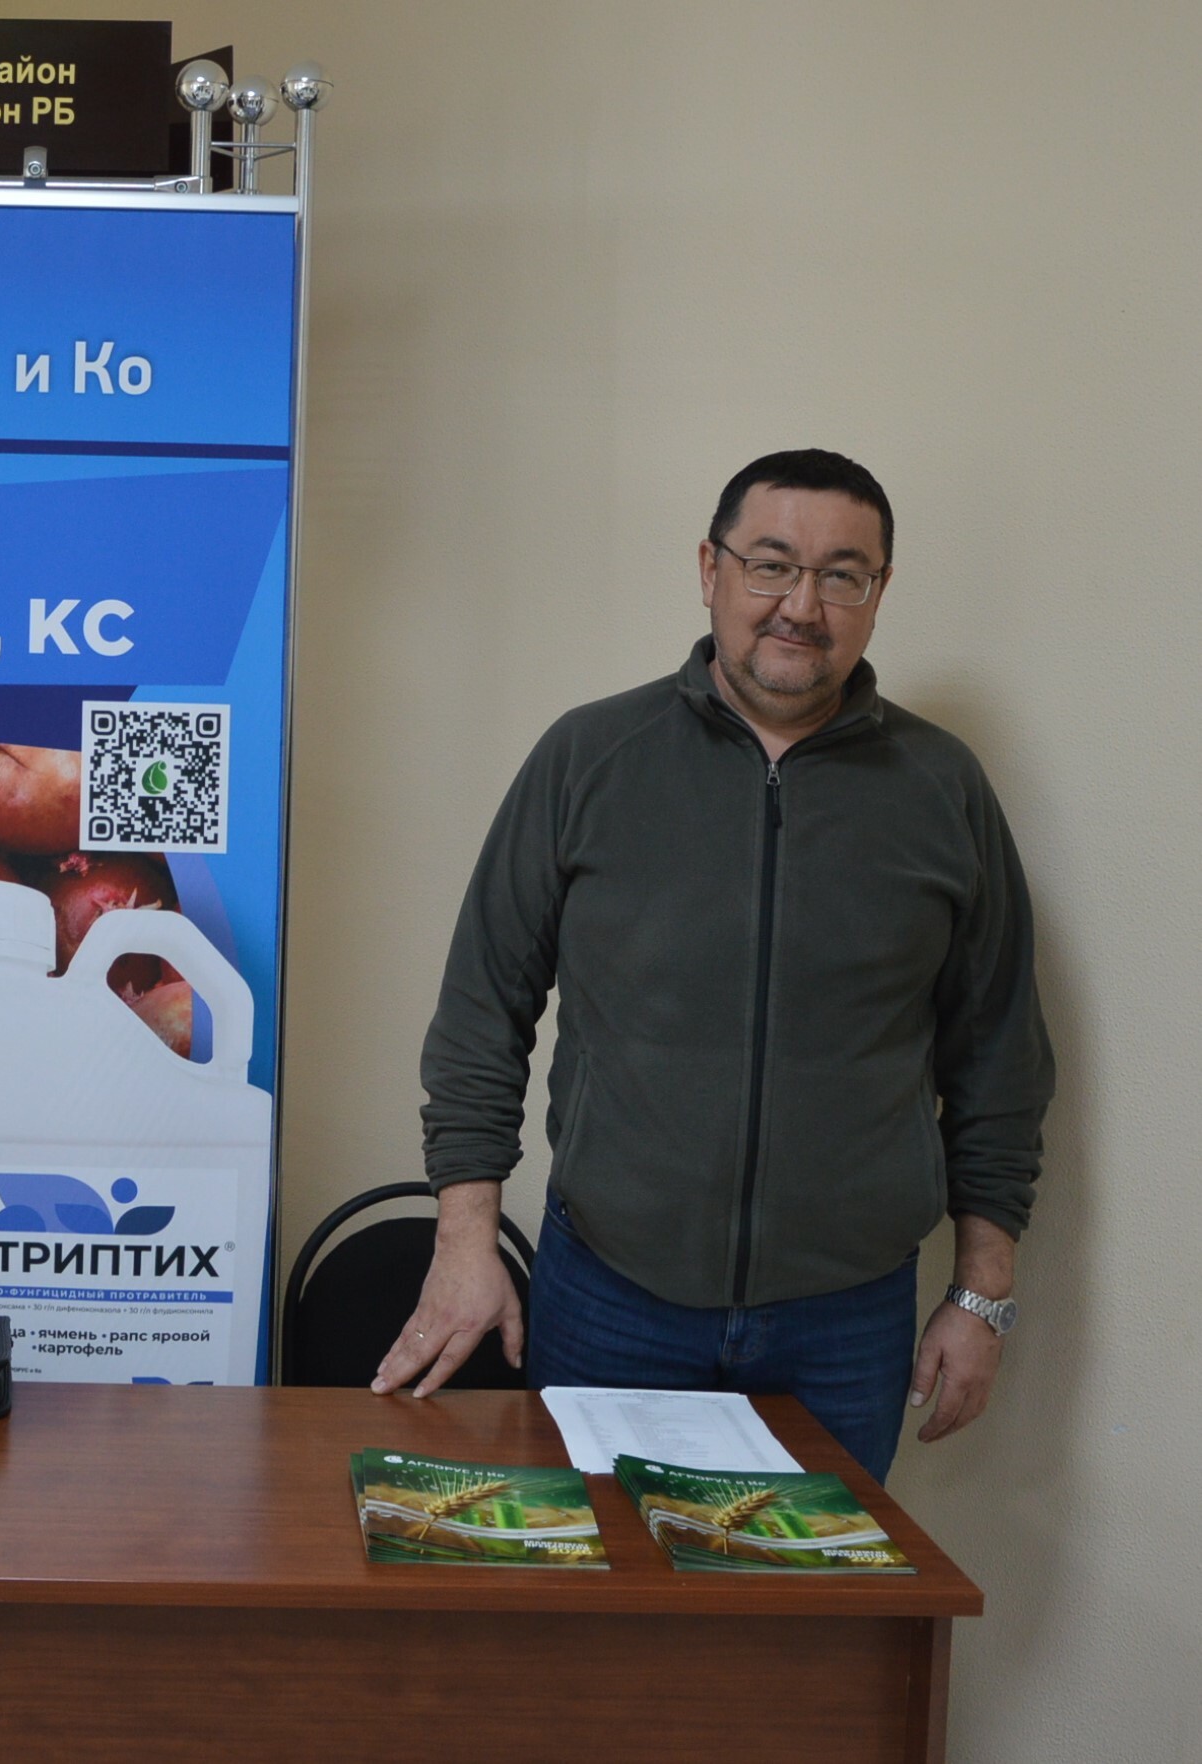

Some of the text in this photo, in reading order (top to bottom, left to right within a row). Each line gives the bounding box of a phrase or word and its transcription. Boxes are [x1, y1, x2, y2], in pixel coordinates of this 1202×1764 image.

[31, 97, 75, 126] РБ
[15, 353, 50, 393] и
[74, 341, 152, 396] Ко
[28, 597, 135, 657] КС
[109, 1291, 207, 1301] ПРОТРАВИТЕЛЬ
[38, 1329, 97, 1340] ячмень
[109, 1330, 148, 1344] рапс
[152, 1327, 210, 1344] яровой
[38, 1343, 124, 1357] картофель
[407, 1460, 470, 1475] АГРОРУС
